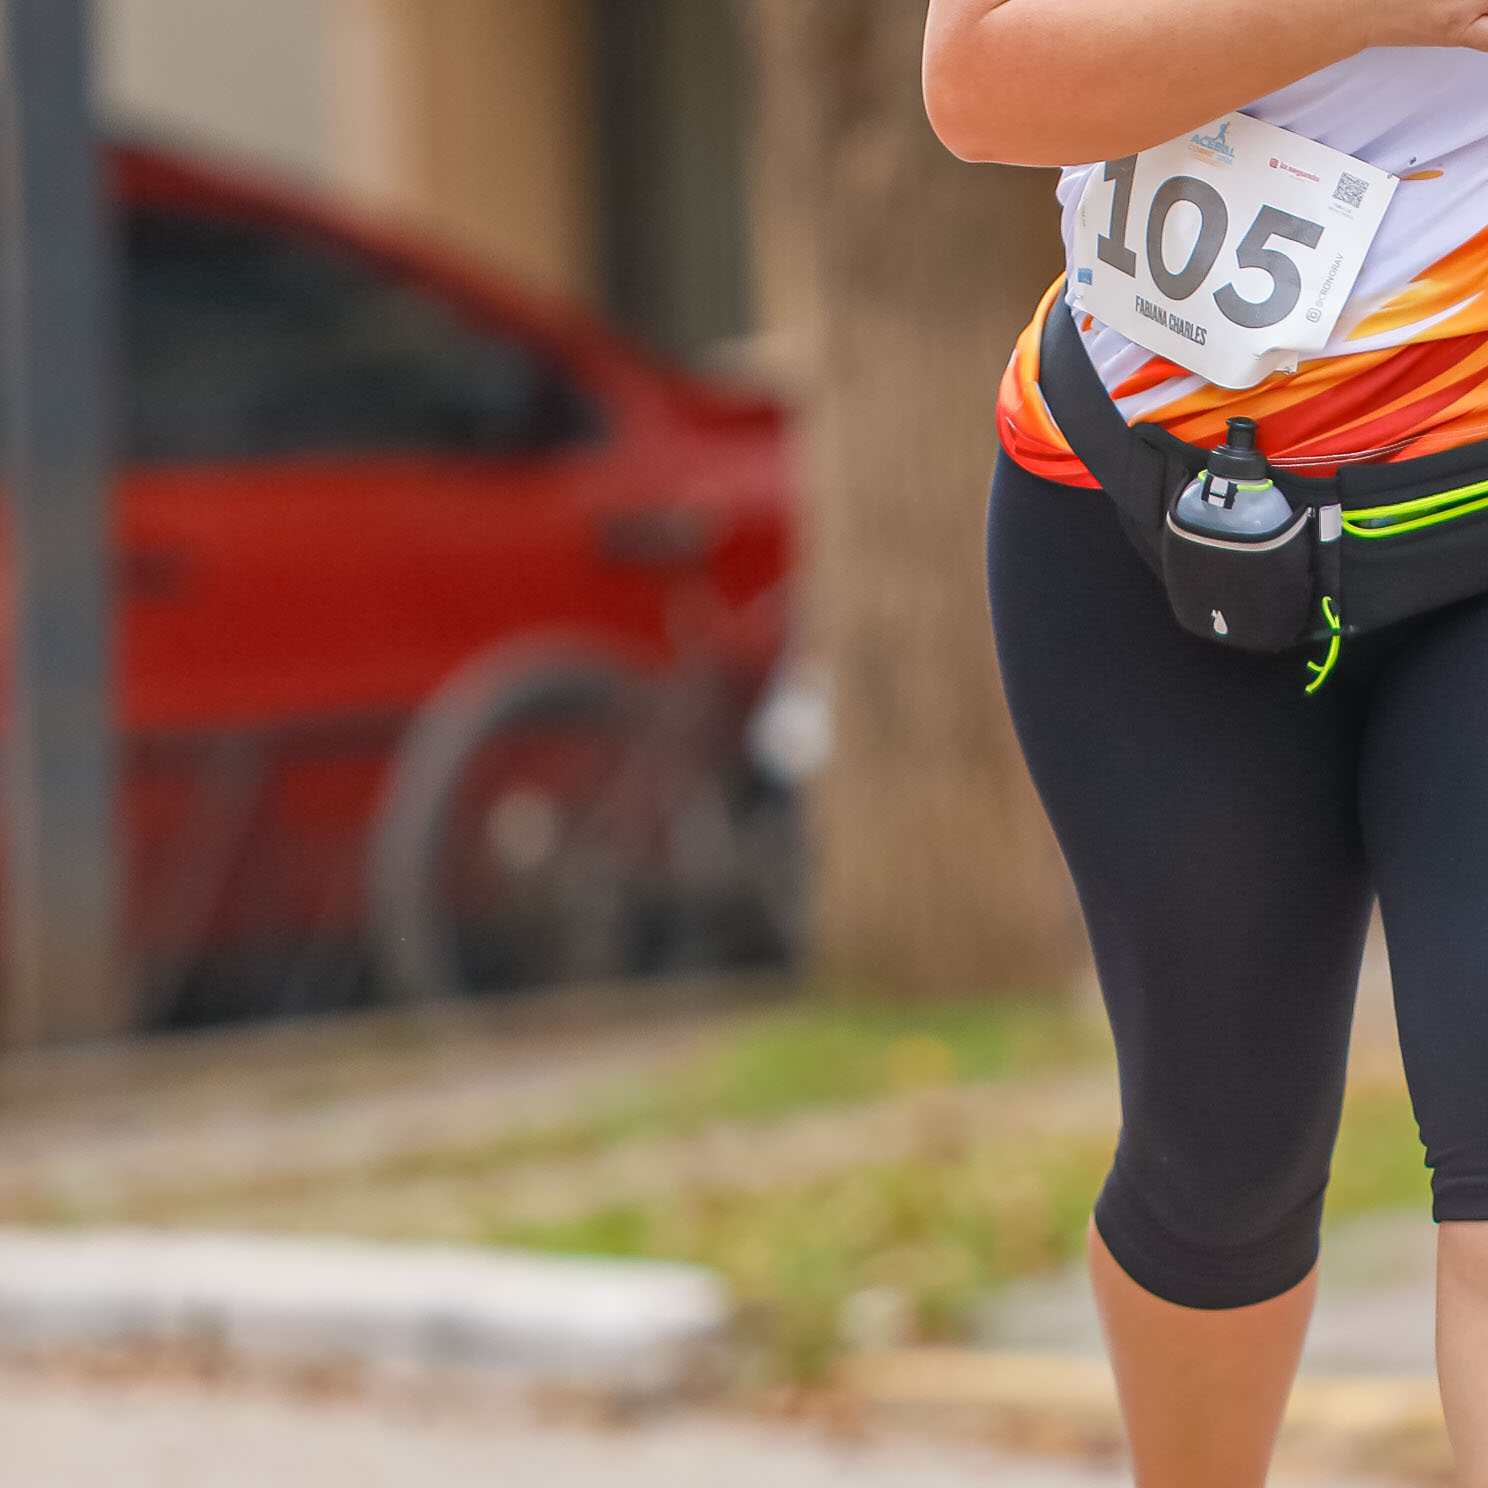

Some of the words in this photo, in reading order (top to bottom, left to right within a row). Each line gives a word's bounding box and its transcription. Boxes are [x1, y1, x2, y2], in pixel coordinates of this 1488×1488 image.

[1097, 152, 1326, 329] 105
[1135, 294, 1168, 328] FABIANA
[1168, 313, 1208, 346] CHARLES
